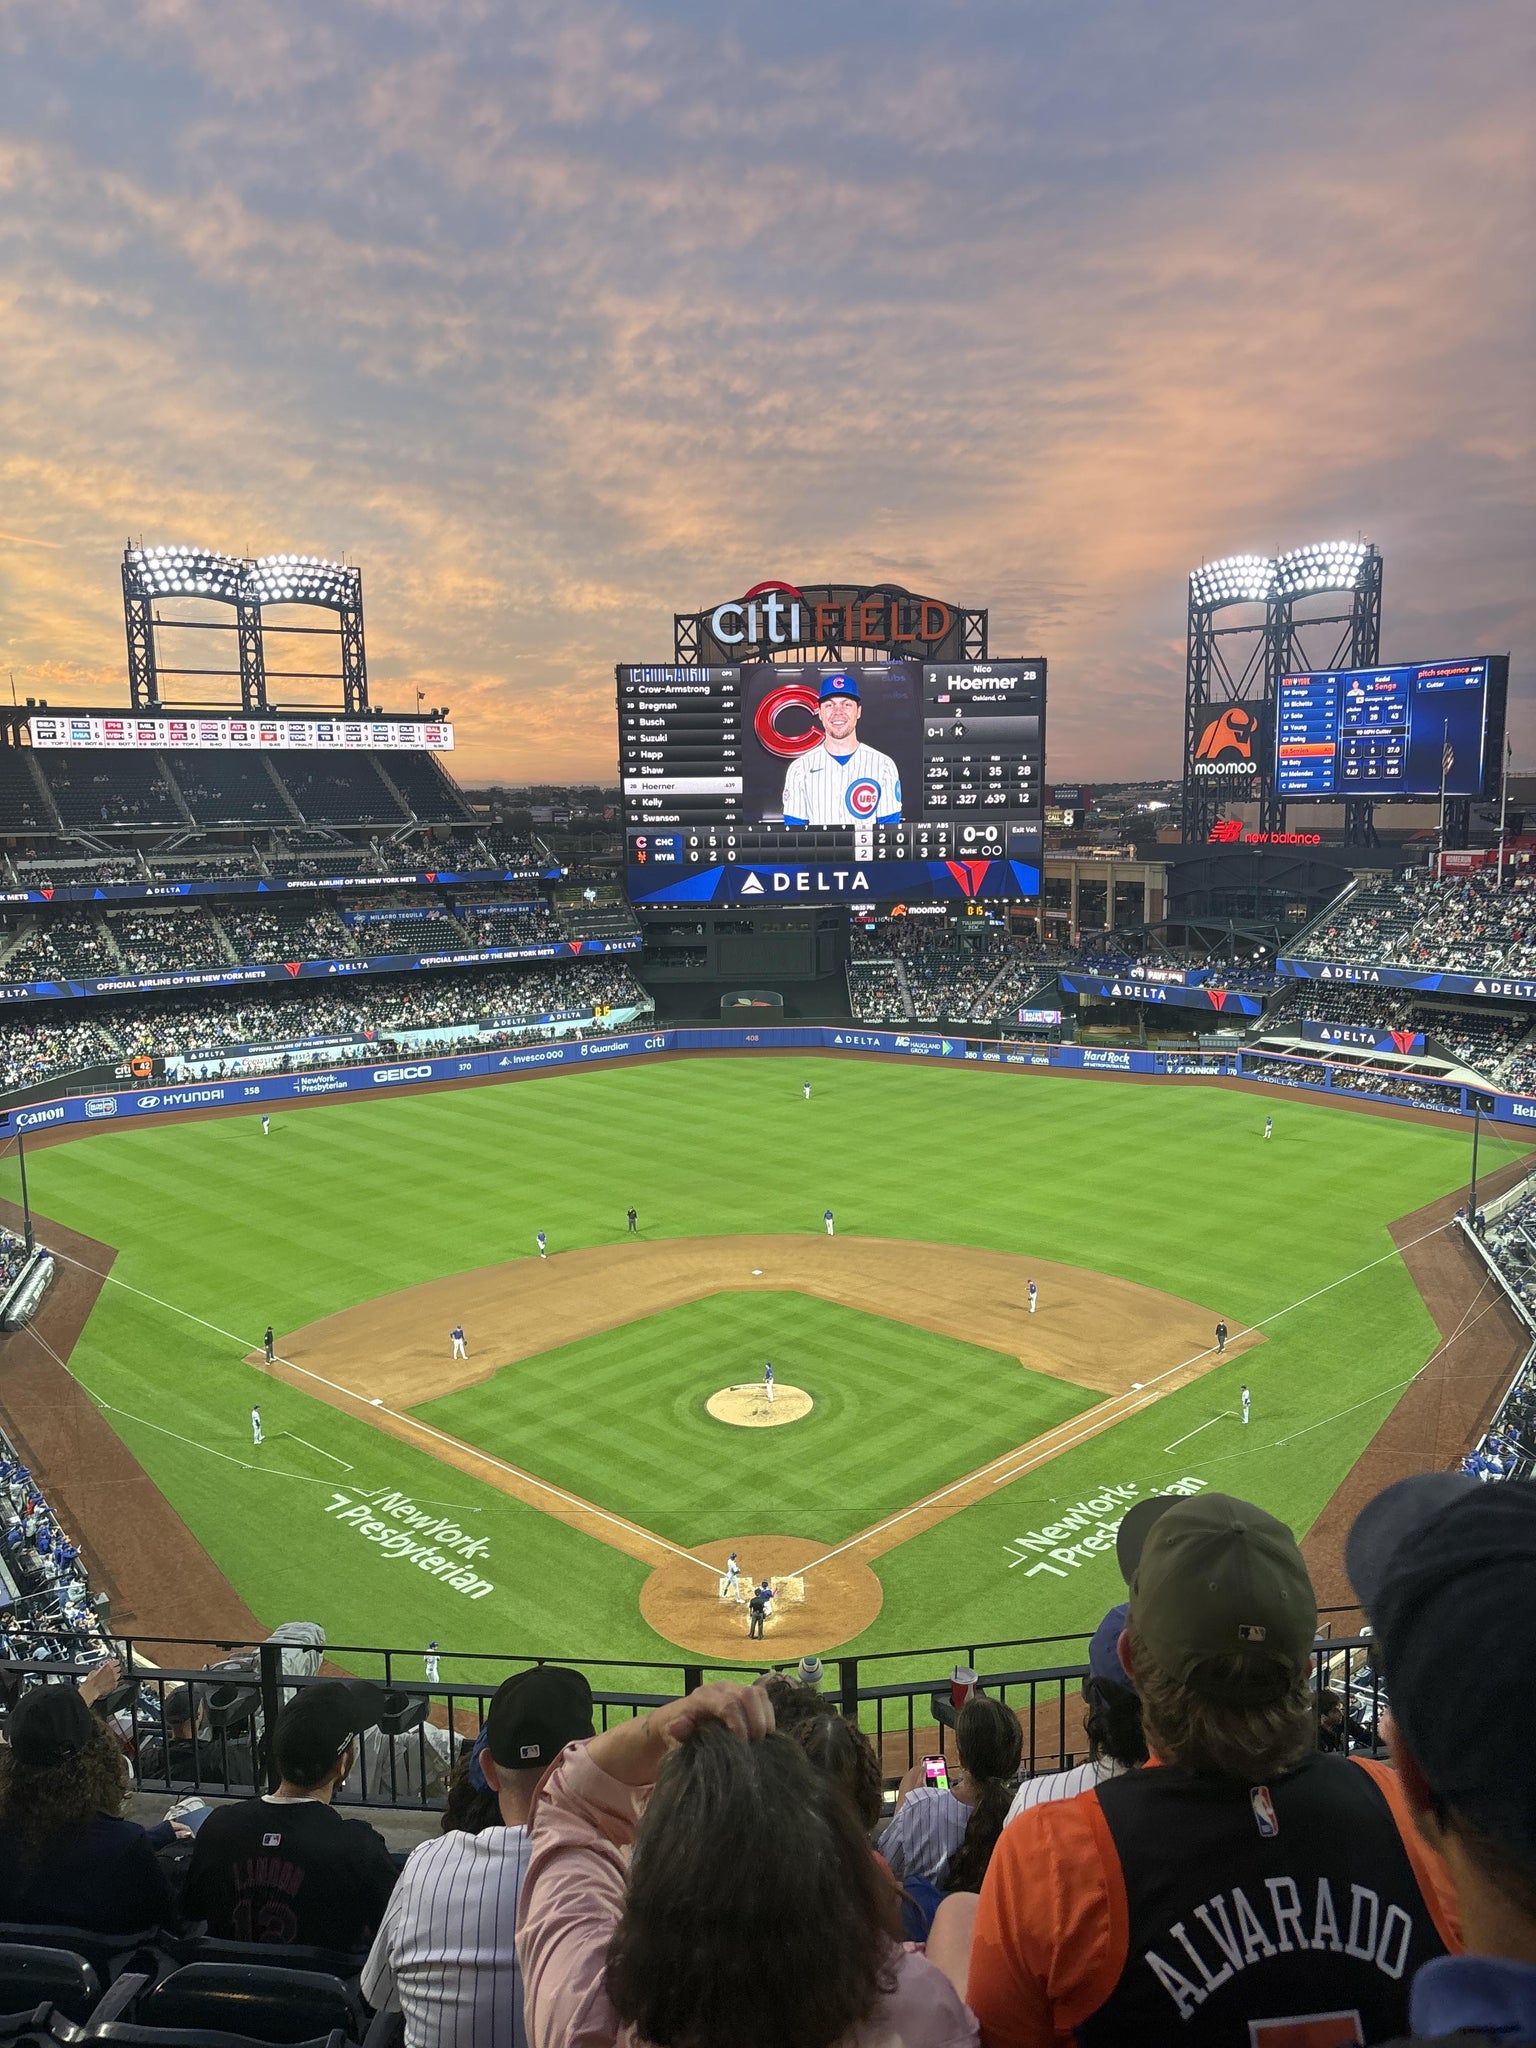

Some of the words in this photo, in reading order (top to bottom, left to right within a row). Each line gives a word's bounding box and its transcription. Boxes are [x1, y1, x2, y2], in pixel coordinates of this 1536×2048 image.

[711, 592, 800, 643] citi
[815, 600, 950, 641] FIELD
[973, 665, 992, 673] Nico
[1417, 670, 1436, 680] pitch
[1436, 667, 1470, 677] sequence
[930, 673, 937, 682] 2
[947, 675, 1018, 690] Hoerner
[1023, 671, 1037, 680] 2B
[638, 685, 710, 695] Crow-Armstrong
[1375, 683, 1397, 692] Senga
[639, 702, 677, 712] Bregman
[639, 717, 665, 726] Busch
[927, 728, 944, 737] 0-1
[640, 734, 668, 742] Suzuki
[1290, 736, 1306, 744] Ewing
[640, 750, 664, 760] Happ
[641, 766, 664, 774] Shaw
[927, 768, 949, 777] .234
[963, 767, 970, 777] 4
[989, 766, 1002, 776] 35
[1018, 766, 1031, 776] 28
[1194, 762, 1257, 775] moomoo
[641, 782, 676, 790] Hoerner
[642, 798, 663, 808] Kelly
[928, 795, 947, 805] .312
[956, 794, 977, 804] .327
[984, 794, 1006, 804] .639
[1019, 793, 1030, 803] 12
[643, 814, 680, 822] Swanson
[963, 826, 998, 842] 0-0
[1244, 833, 1269, 844] new
[1270, 831, 1321, 844] balance
[655, 838, 674, 846] CHC
[690, 836, 698, 846] 0
[709, 836, 717, 846] 5
[727, 836, 736, 846] 0
[655, 853, 675, 861] NYM
[517, 871, 540, 879] DELTA
[287, 880, 317, 888] OFFICIAL
[773, 871, 869, 891] DELTA
[908, 906, 947, 914] moomoo
[612, 942, 636, 951] DELTA
[420, 956, 452, 965] OFFICIAL
[537, 948, 555, 956] METS
[338, 961, 369, 971] DELTA
[1335, 967, 1379, 982] DELTA
[96, 980, 137, 991] OFFICIAL
[138, 977, 172, 988] AIRLINE
[172, 977, 184, 985] OF
[185, 975, 201, 984] THE
[202, 973, 221, 982] NEW
[221, 972, 244, 981] YORK
[244, 970, 266, 979] METS
[0, 989, 28, 998] ELTA
[1124, 985, 1166, 1000] DELTA
[1491, 983, 1536, 999] DELT
[556, 1010, 581, 1020] DELTA
[501, 1017, 526, 1026] DELTA
[745, 1034, 759, 1042] 408
[845, 1035, 880, 1046] DELTA
[1333, 1029, 1376, 1044] DELTA
[589, 1041, 629, 1055] Guardian
[644, 1036, 665, 1050] citi
[910, 1042, 941, 1050] HAUGLAND
[198, 1050, 225, 1058] DELTA
[910, 1047, 929, 1055] GROUP
[964, 1051, 978, 1059] 380
[513, 1052, 545, 1064] Invesco
[546, 1049, 564, 1059] QQQ
[982, 1053, 1000, 1061] GOYA
[1006, 1055, 1025, 1063] GOYA
[1031, 1056, 1050, 1065] GOYA
[1083, 1050, 1106, 1062] Hard
[1107, 1052, 1130, 1064] Rock
[114, 1064, 131, 1075] citi
[140, 1062, 150, 1070] 42
[458, 1062, 472, 1072] 370
[1185, 1066, 1219, 1075] DUNKIN'
[1226, 1067, 1237, 1075] 370
[373, 1065, 432, 1083] GEICO
[301, 1074, 337, 1085] NewYork-
[1257, 1075, 1299, 1088] CADILLAC
[243, 1085, 260, 1096] 358
[301, 1081, 348, 1093] Presbyterian
[163, 1089, 224, 1105] HYUNDAI
[1411, 1100, 1462, 1115] CADILLAC
[16, 1106, 64, 1127] Canon
[1013, 1482, 1139, 1553] NewYork-
[371, 1492, 491, 1559] NewYork-
[335, 1504, 494, 1600] Presbyterian
[1145, 1876, 1412, 2020] ALVARADO
